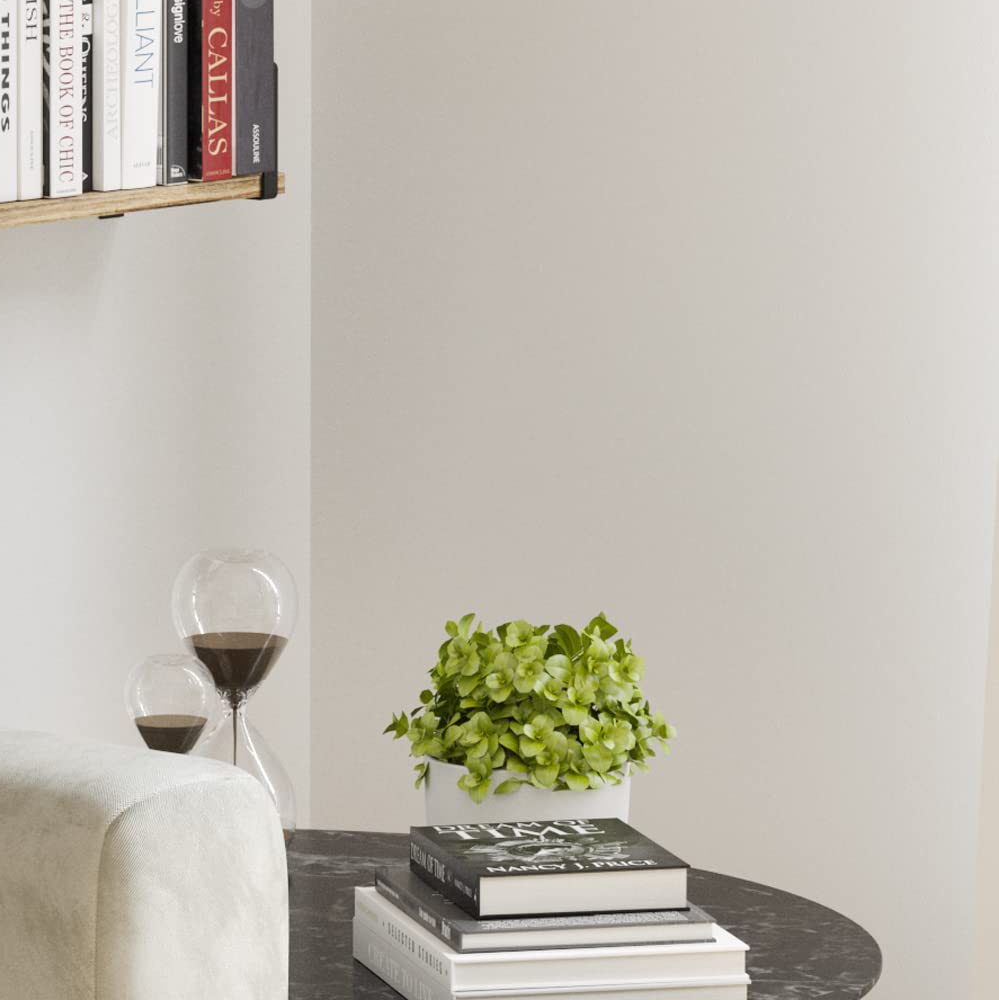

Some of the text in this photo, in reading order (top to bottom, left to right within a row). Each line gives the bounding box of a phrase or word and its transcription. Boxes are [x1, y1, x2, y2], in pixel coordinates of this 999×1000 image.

[59, 0, 74, 40] THE
[209, 0, 223, 16] by
[1, 12, 10, 133] THINGS
[59, 46, 74, 100] BOOK
[208, 27, 228, 156] CALLAS
[59, 105, 74, 129] OF
[59, 136, 74, 182] CHIC
[252, 124, 260, 163] ASSOULINE
[438, 823, 605, 840] TIME
[486, 859, 658, 873] NANCY J. PRICE
